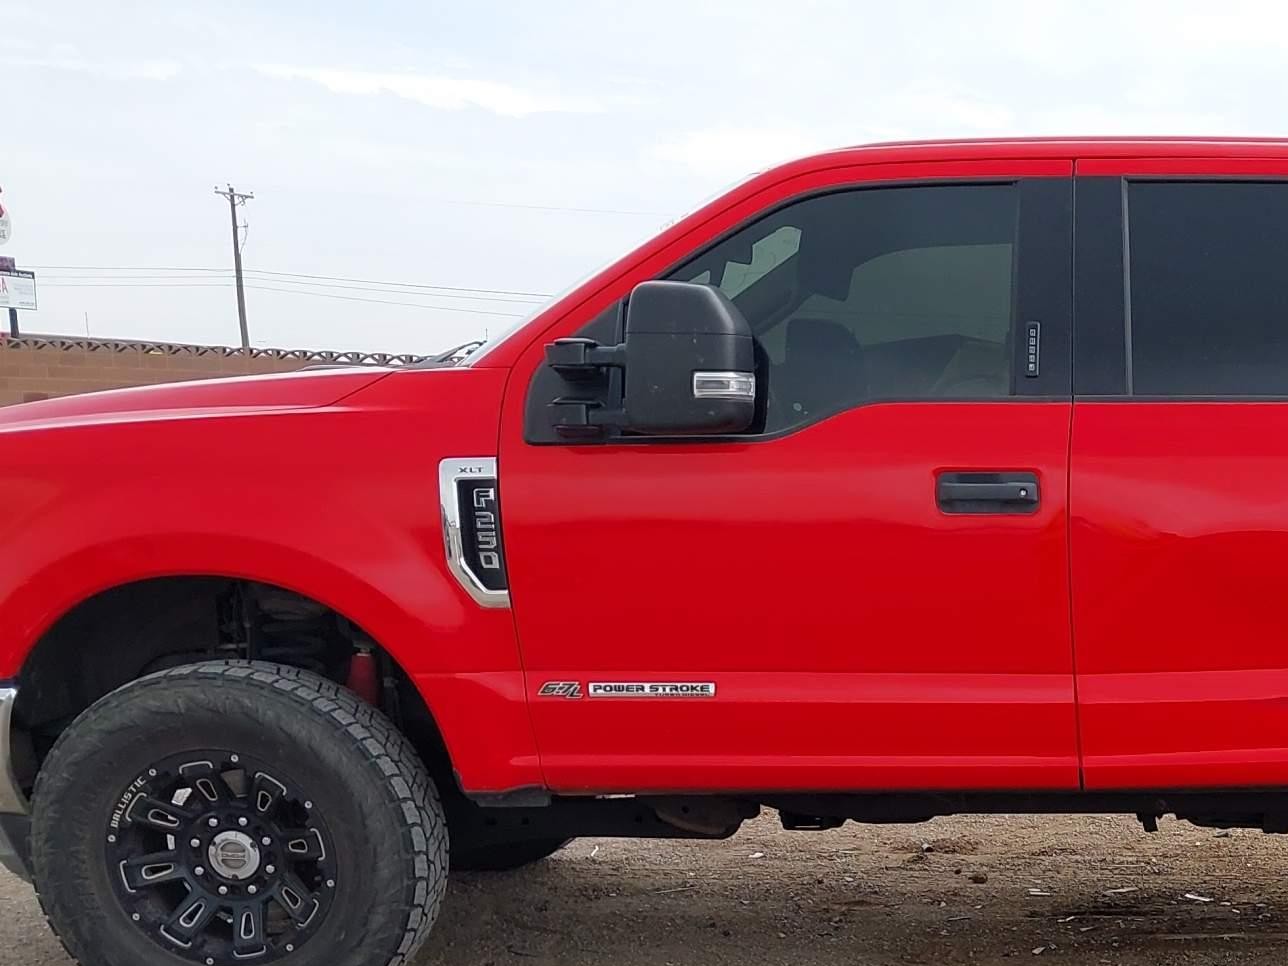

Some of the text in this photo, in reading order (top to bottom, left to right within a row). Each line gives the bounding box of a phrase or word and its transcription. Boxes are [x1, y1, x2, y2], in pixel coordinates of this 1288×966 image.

[458, 466, 484, 474] XLT
[473, 487, 500, 569] F250
[593, 684, 646, 693] POWER
[649, 684, 711, 693] STROKE
[110, 776, 147, 828] BALLISTIC
